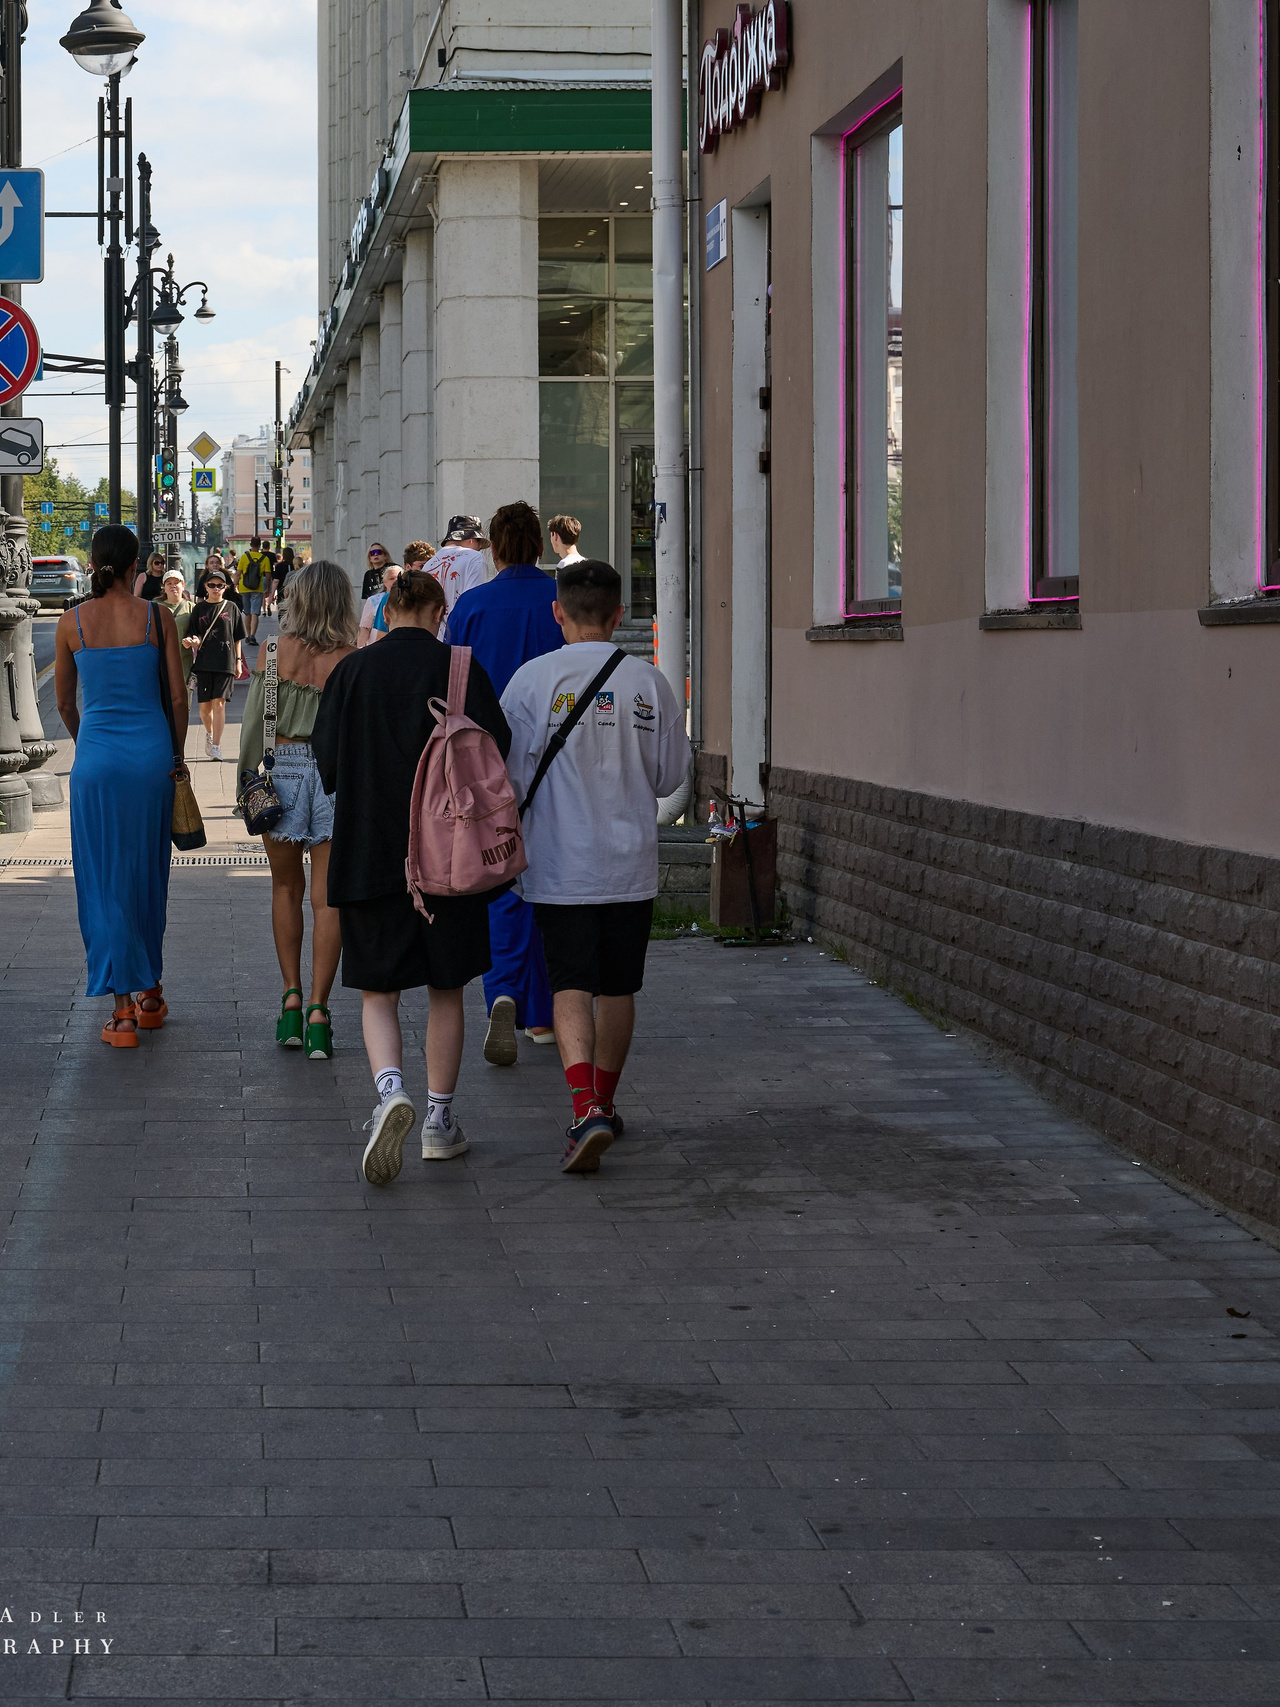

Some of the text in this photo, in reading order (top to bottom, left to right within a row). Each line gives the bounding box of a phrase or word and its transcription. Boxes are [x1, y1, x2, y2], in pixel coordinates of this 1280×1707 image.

[699, 1, 777, 153] Подружка
[153, 532, 181, 542] СТОП
[481, 836, 517, 866] PUMA
